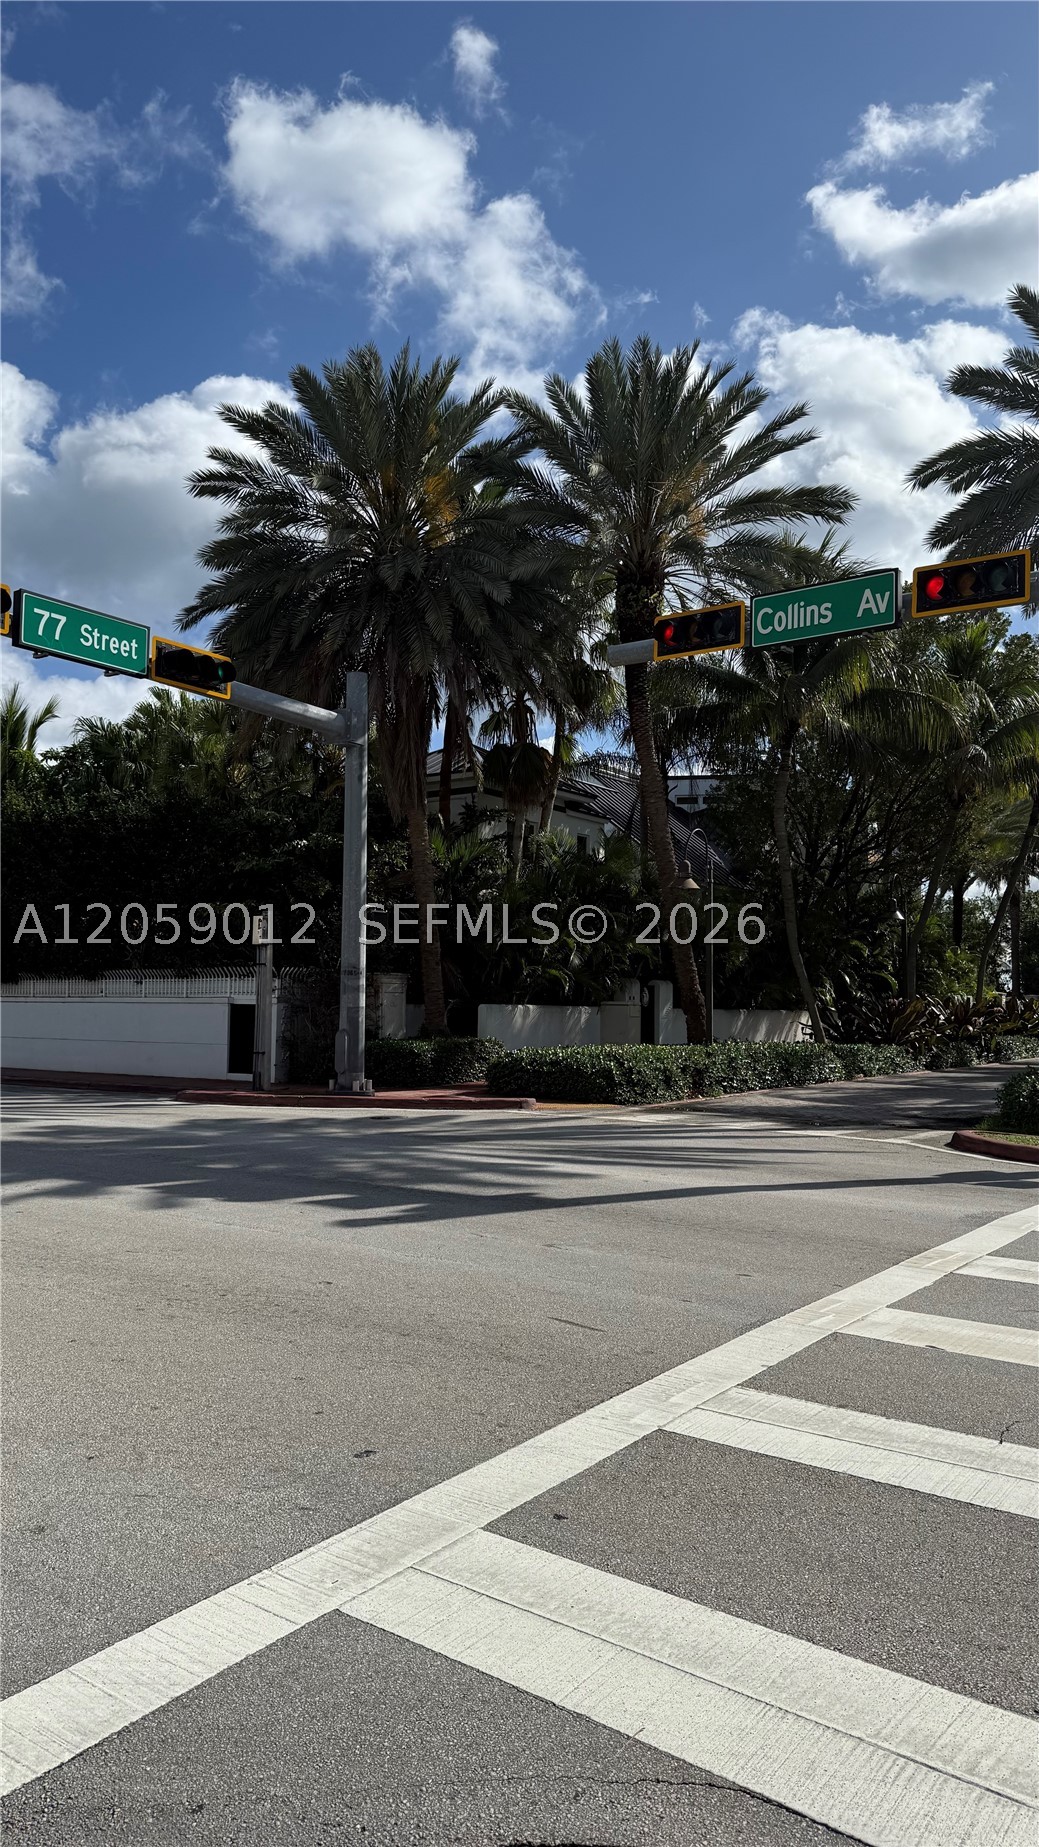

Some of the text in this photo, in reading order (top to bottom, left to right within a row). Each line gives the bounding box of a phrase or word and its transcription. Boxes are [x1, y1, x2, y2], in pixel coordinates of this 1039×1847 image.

[33, 608, 138, 660] 77 Street
[756, 588, 890, 635] Collins Av
